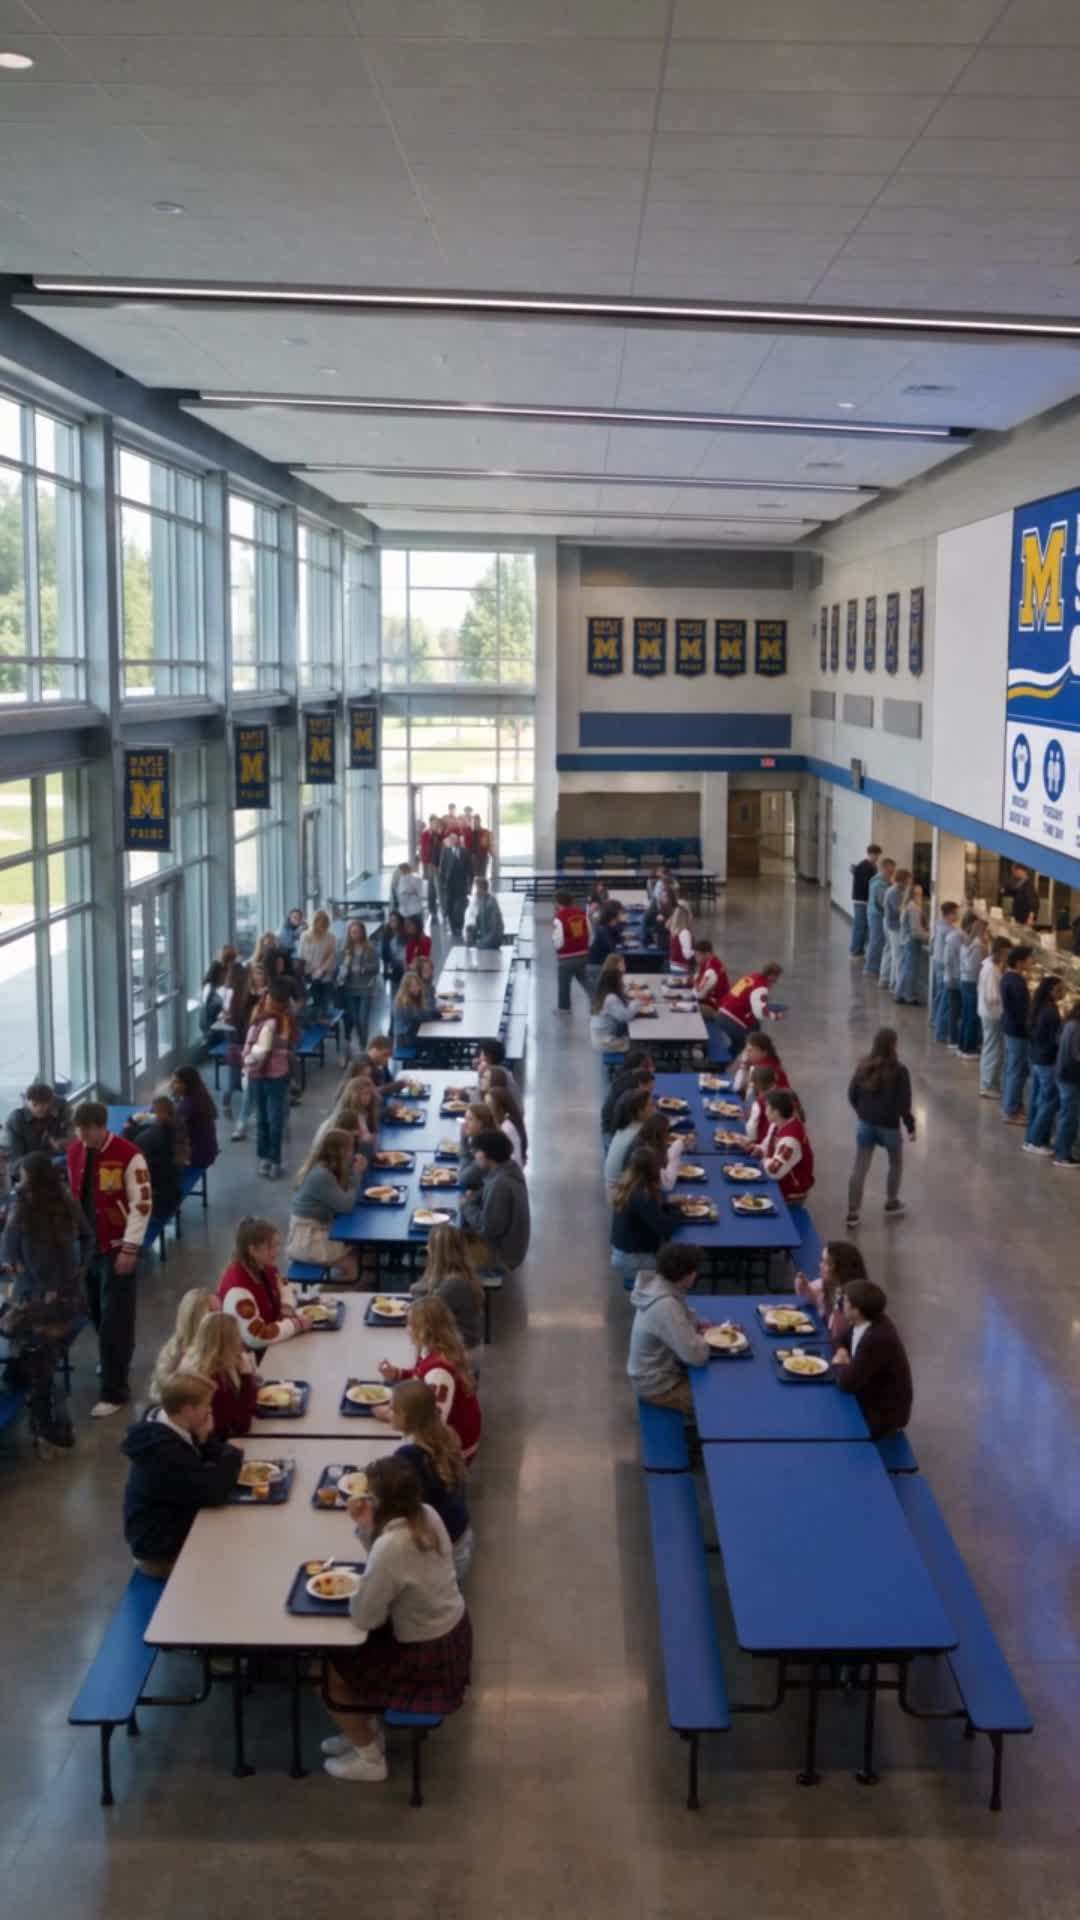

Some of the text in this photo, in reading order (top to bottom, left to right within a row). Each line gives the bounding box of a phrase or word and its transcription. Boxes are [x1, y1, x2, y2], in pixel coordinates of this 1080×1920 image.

[1018, 520, 1068, 633] M
[593, 638, 618, 660] M
[639, 638, 662, 659] M
[680, 639, 703, 659] M
[720, 639, 743, 659] M
[760, 639, 783, 659] M
[310, 737, 332, 762] M
[240, 752, 265, 784] M
[129, 780, 165, 819] M
[99, 1168, 123, 1191] M
